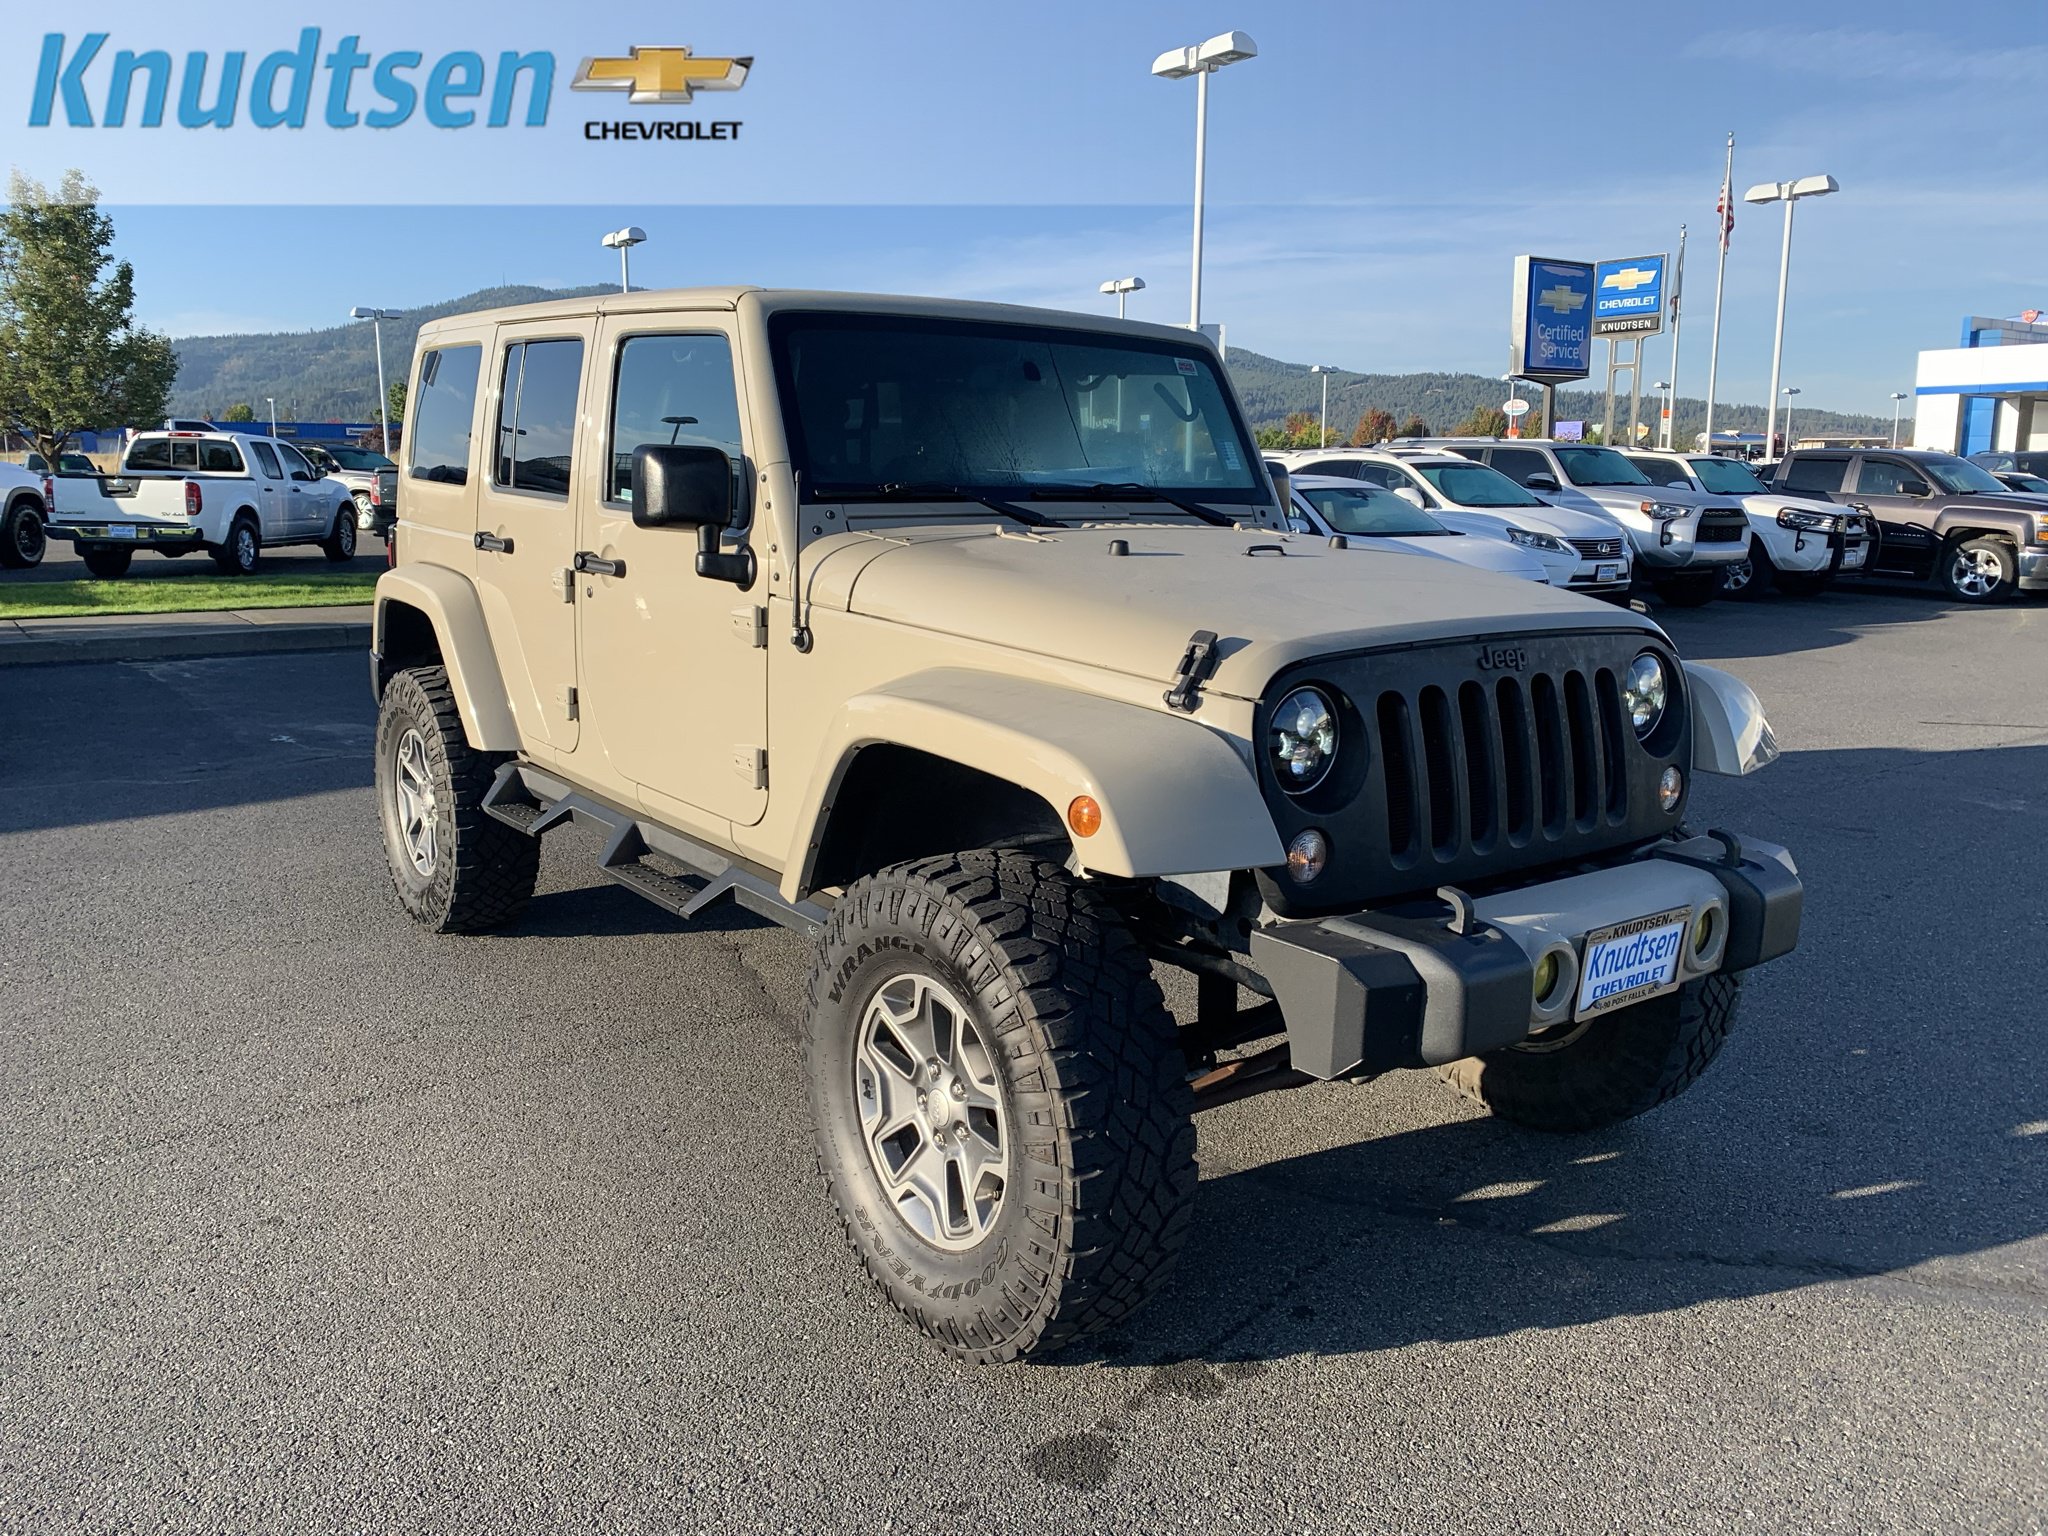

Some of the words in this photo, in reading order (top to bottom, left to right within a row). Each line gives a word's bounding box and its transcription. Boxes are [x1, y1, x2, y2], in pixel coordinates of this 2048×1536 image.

[1599, 295, 1656, 310] CHEVROLET
[1537, 323, 1585, 342] Certified
[1601, 319, 1651, 332] KNUDTSEN
[1540, 342, 1580, 360] Service
[1478, 644, 1527, 671] Jeep
[1588, 931, 1679, 982] Knudtsen
[1592, 964, 1667, 999] CHEVROLET
[1611, 994, 1627, 1007] POST
